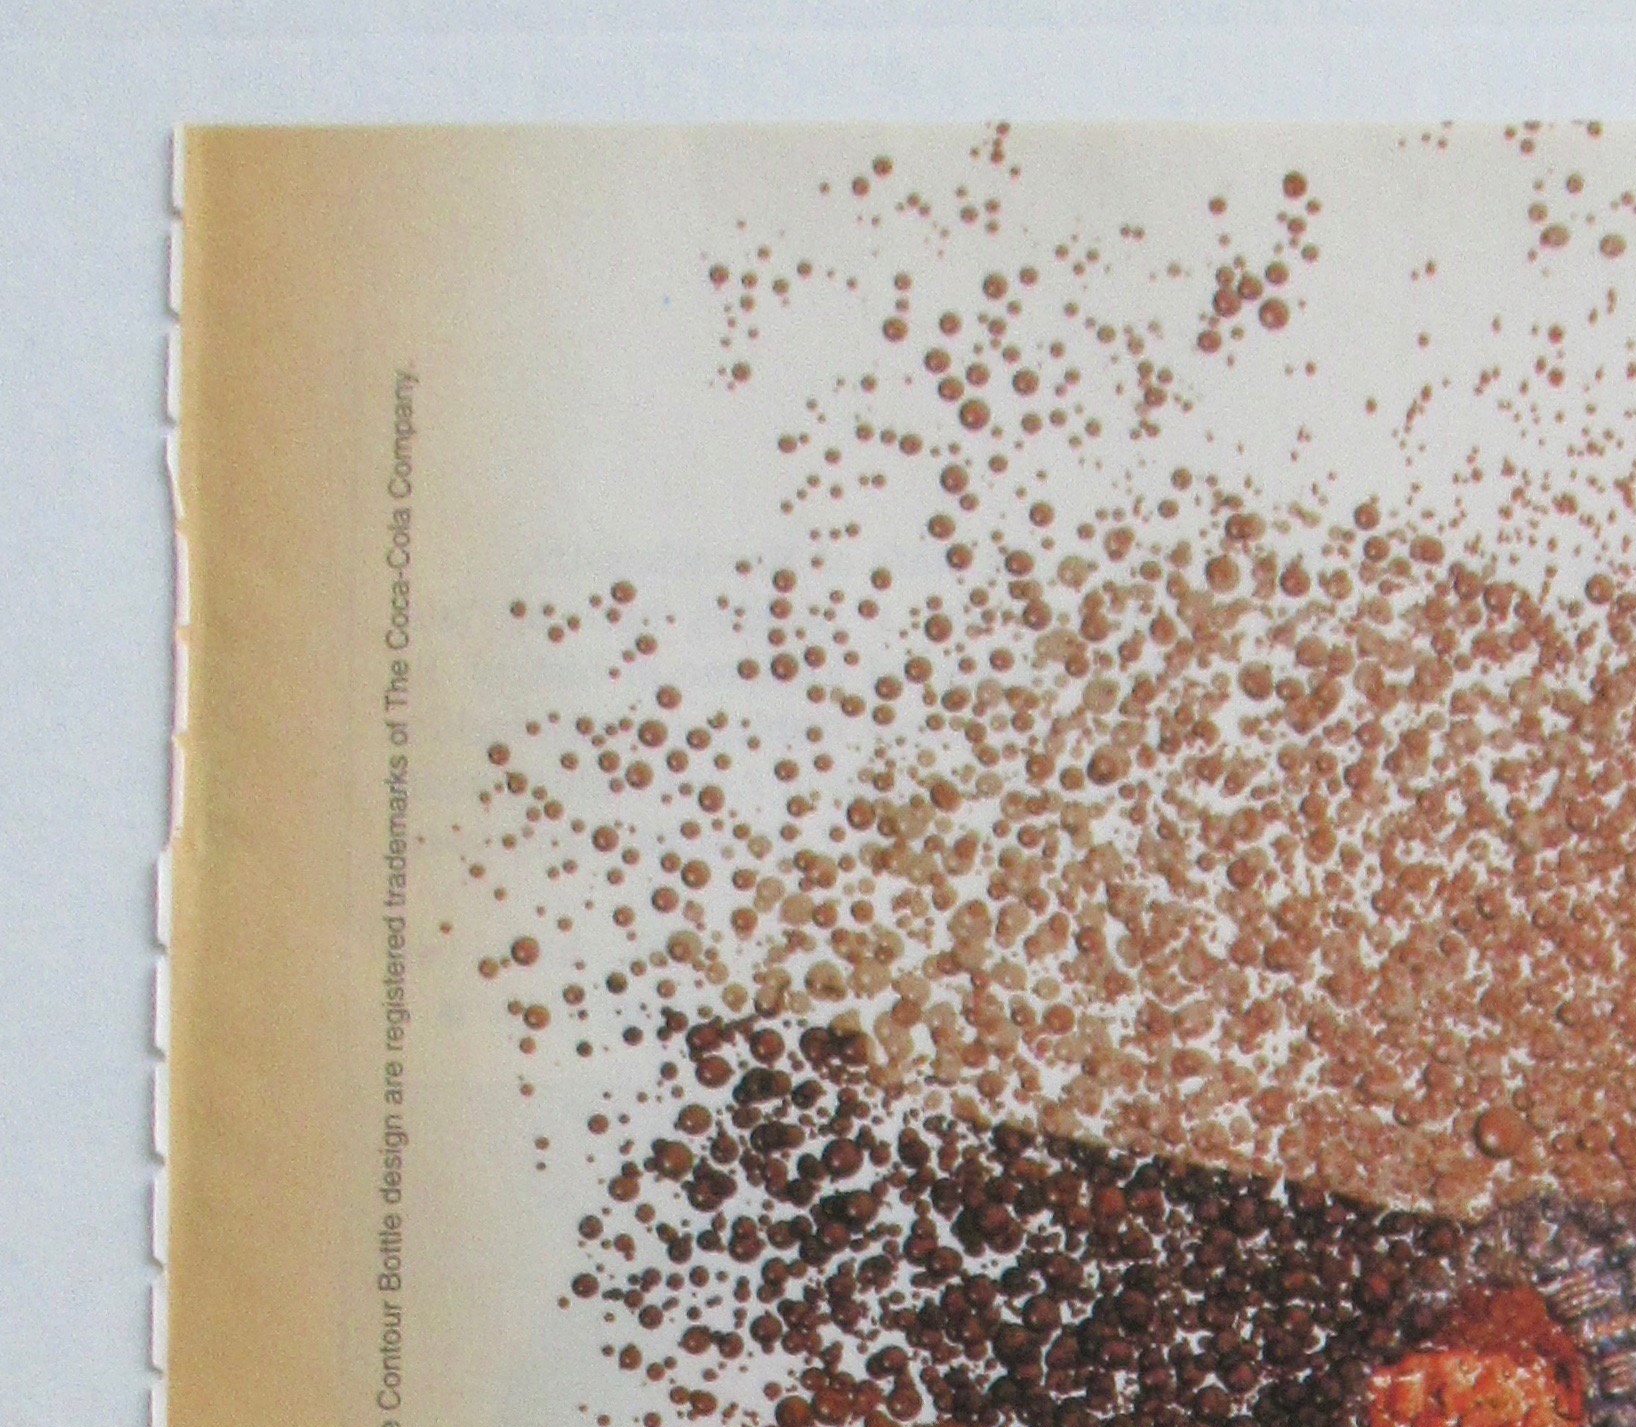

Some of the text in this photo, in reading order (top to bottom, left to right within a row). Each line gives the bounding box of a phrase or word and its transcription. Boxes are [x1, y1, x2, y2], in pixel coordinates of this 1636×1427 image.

[383, 507, 412, 652] Coca-Cola
[382, 658, 411, 713] The
[382, 719, 410, 748] of
[382, 753, 409, 908] trademarks
[380, 915, 412, 1052] registered
[383, 1059, 405, 1106] are
[377, 1113, 410, 1206] design
[375, 1212, 403, 1293] Bottle
[374, 1298, 403, 1412] Contour
